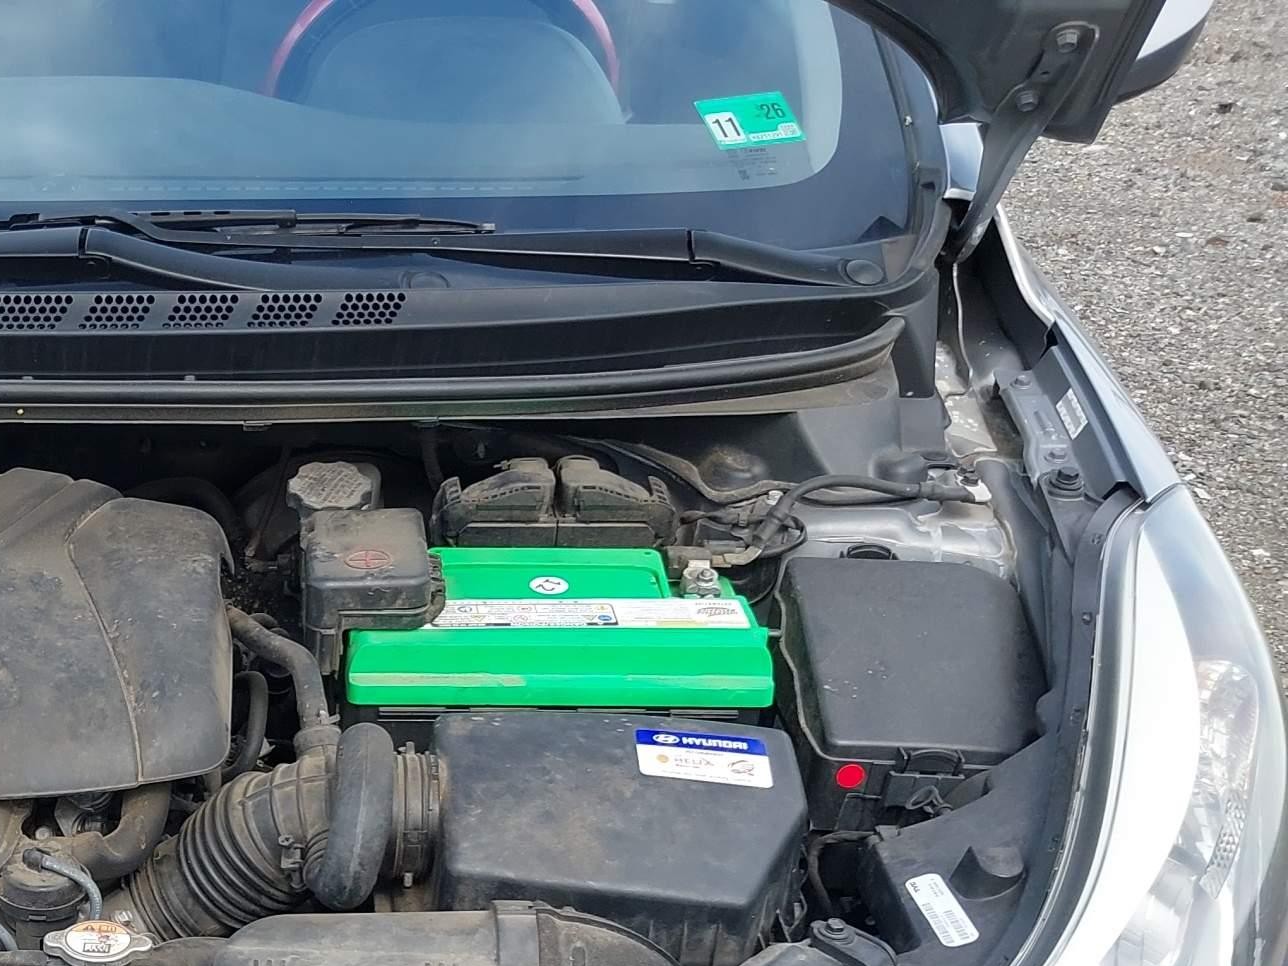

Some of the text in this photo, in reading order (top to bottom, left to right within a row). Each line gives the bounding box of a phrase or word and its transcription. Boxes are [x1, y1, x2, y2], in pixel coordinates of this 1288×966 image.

[760, 103, 786, 120] 26
[712, 117, 741, 138] 11
[682, 736, 748, 750] HYUNDAI
